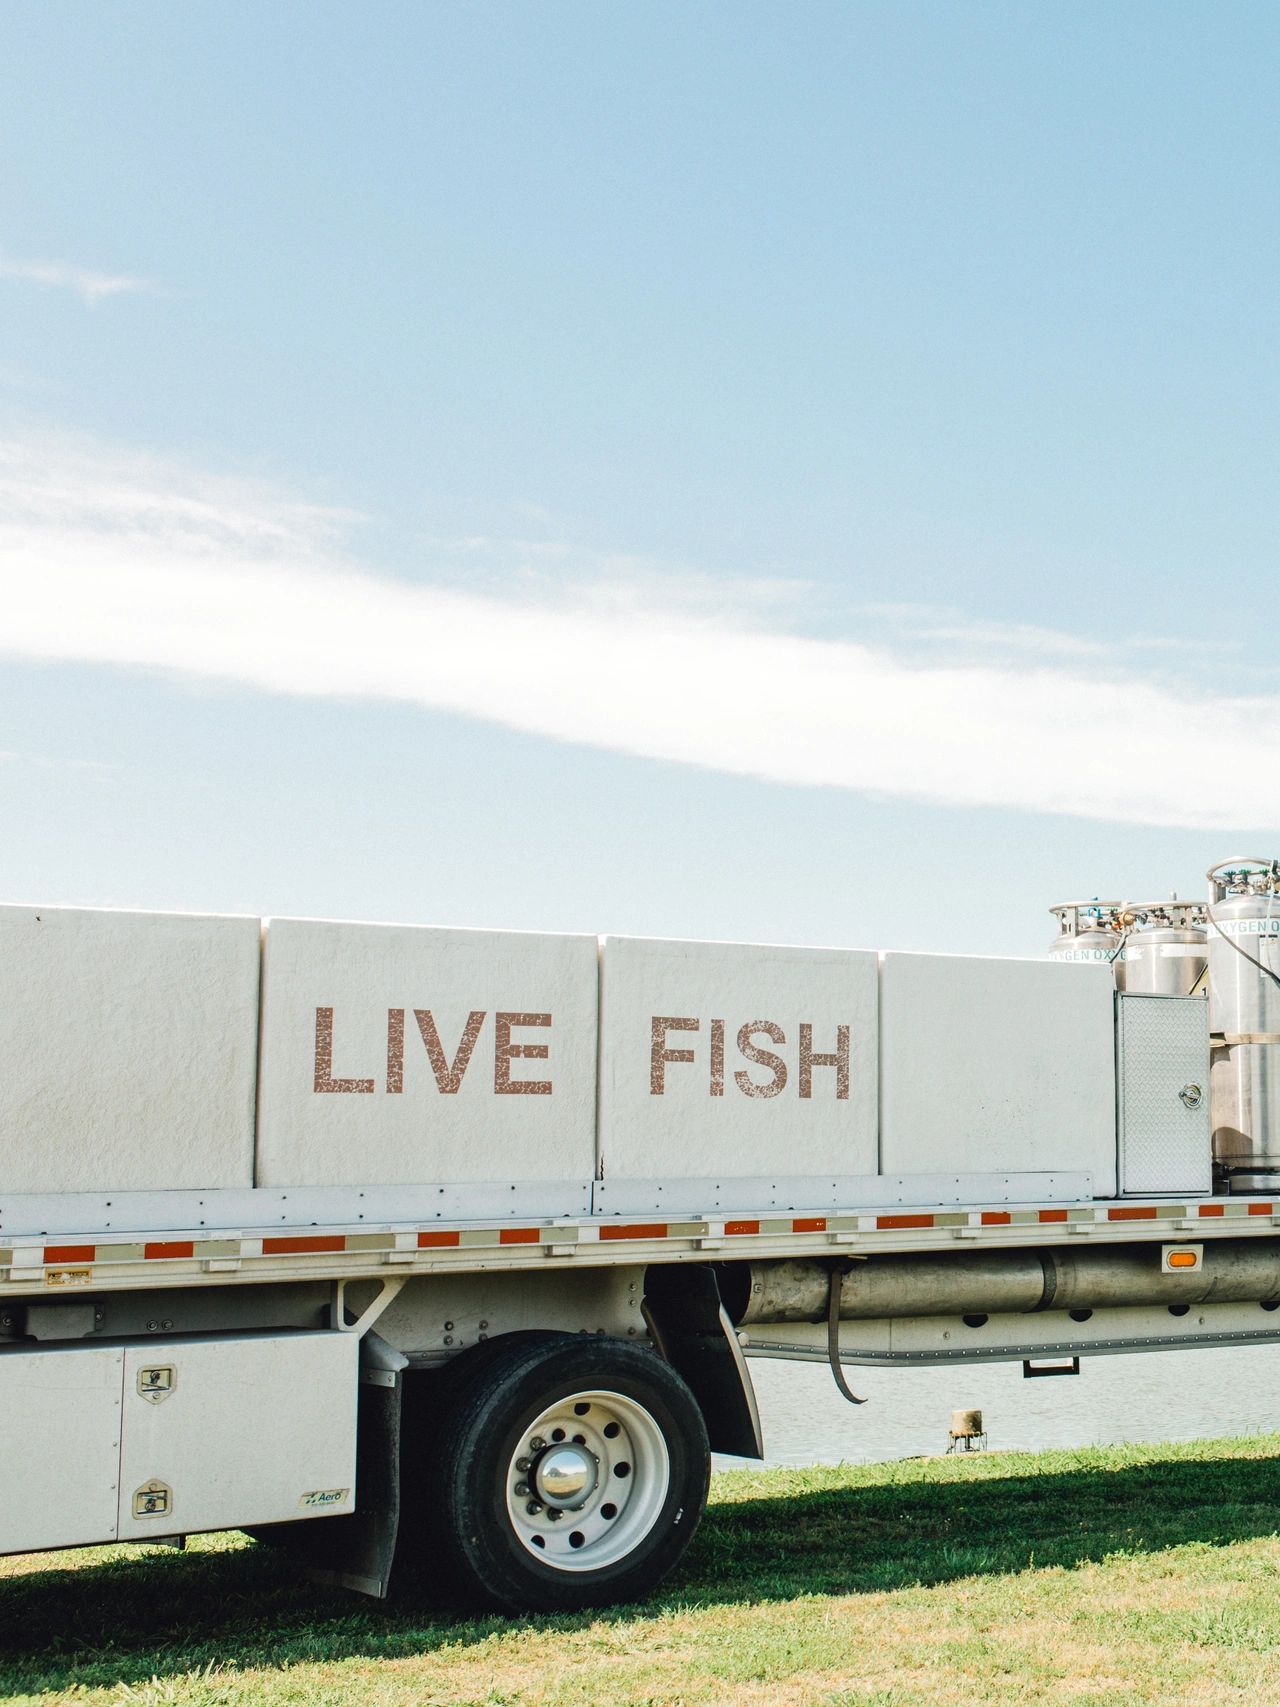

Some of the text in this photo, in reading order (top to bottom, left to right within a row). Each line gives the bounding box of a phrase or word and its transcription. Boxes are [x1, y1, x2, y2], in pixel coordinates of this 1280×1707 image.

[313, 1007, 850, 1100] LIVE FISH
[318, 1492, 342, 1502] Aero
